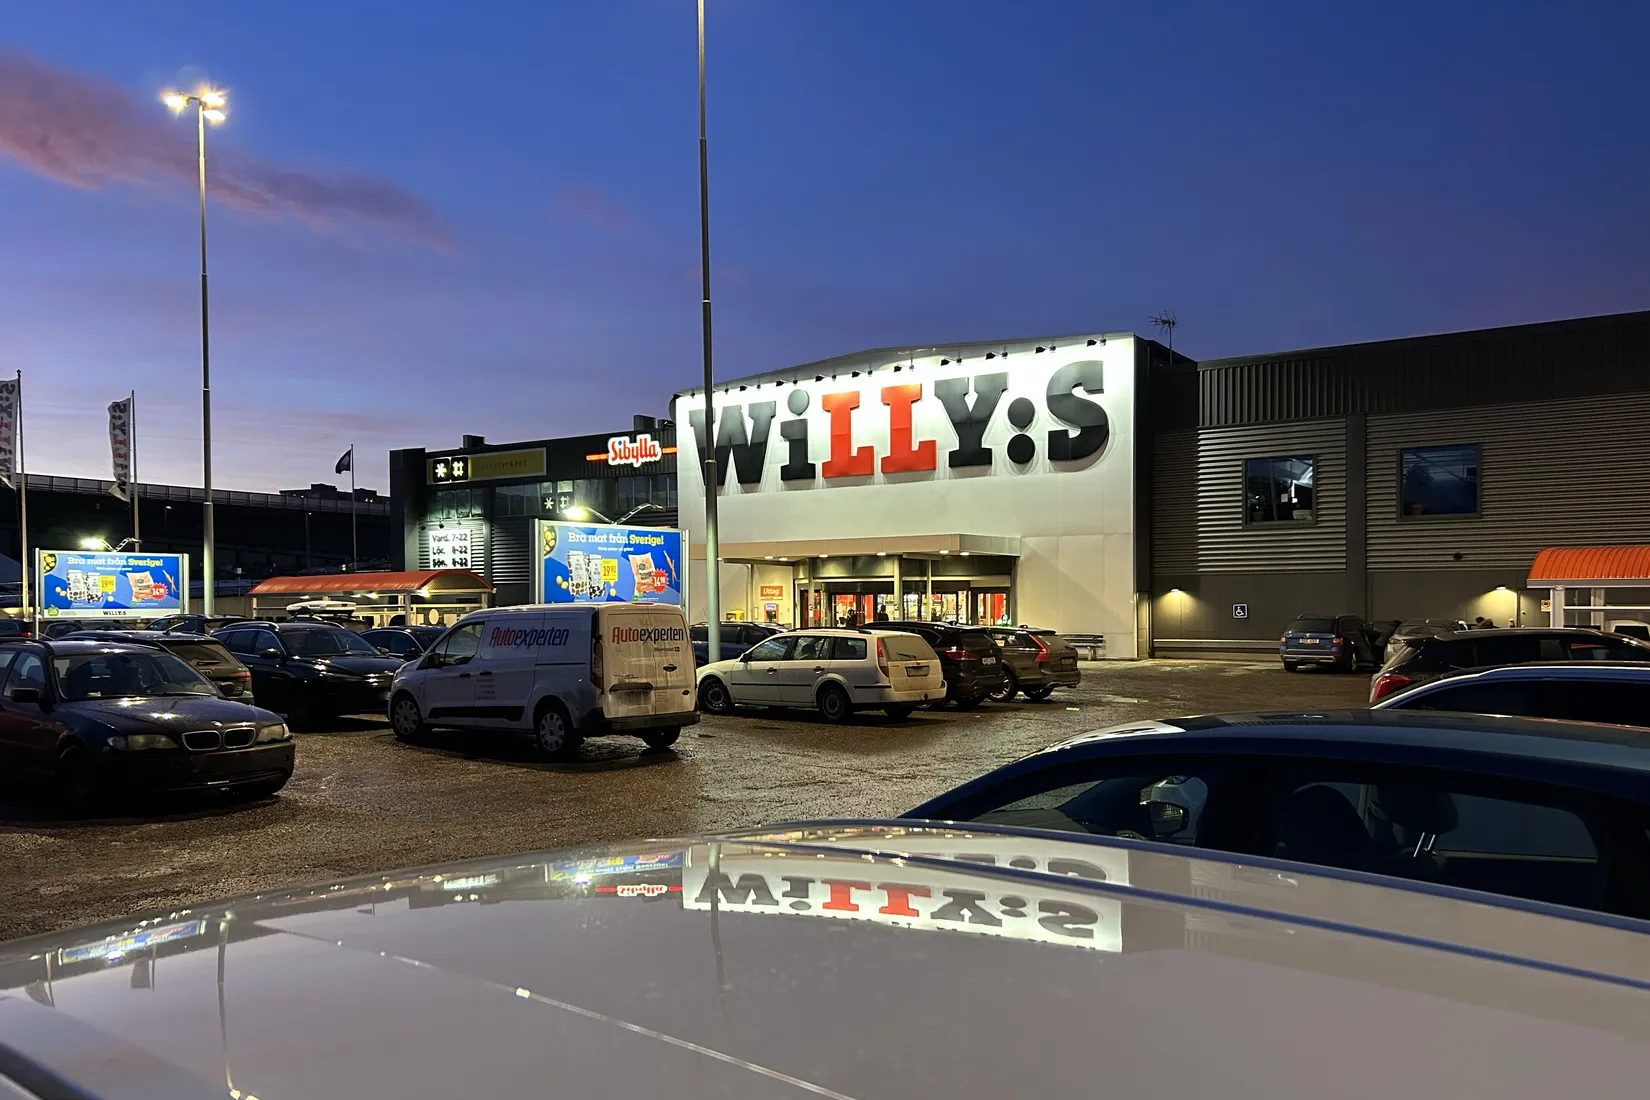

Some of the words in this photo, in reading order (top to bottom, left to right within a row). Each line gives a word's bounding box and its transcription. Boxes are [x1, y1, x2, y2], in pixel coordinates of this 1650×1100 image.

[611, 438, 659, 464] Sibylla
[452, 533, 468, 542] 7-22
[568, 532, 587, 543] Bra
[588, 534, 607, 543] mat
[608, 533, 628, 544] från
[629, 534, 664, 546] Sverige!
[67, 556, 86, 565] Bra
[87, 557, 106, 565] mat
[107, 557, 127, 566] från
[127, 558, 163, 567] Sverige!
[488, 626, 570, 650] Autoexperten
[612, 625, 684, 645] Autoexperten
